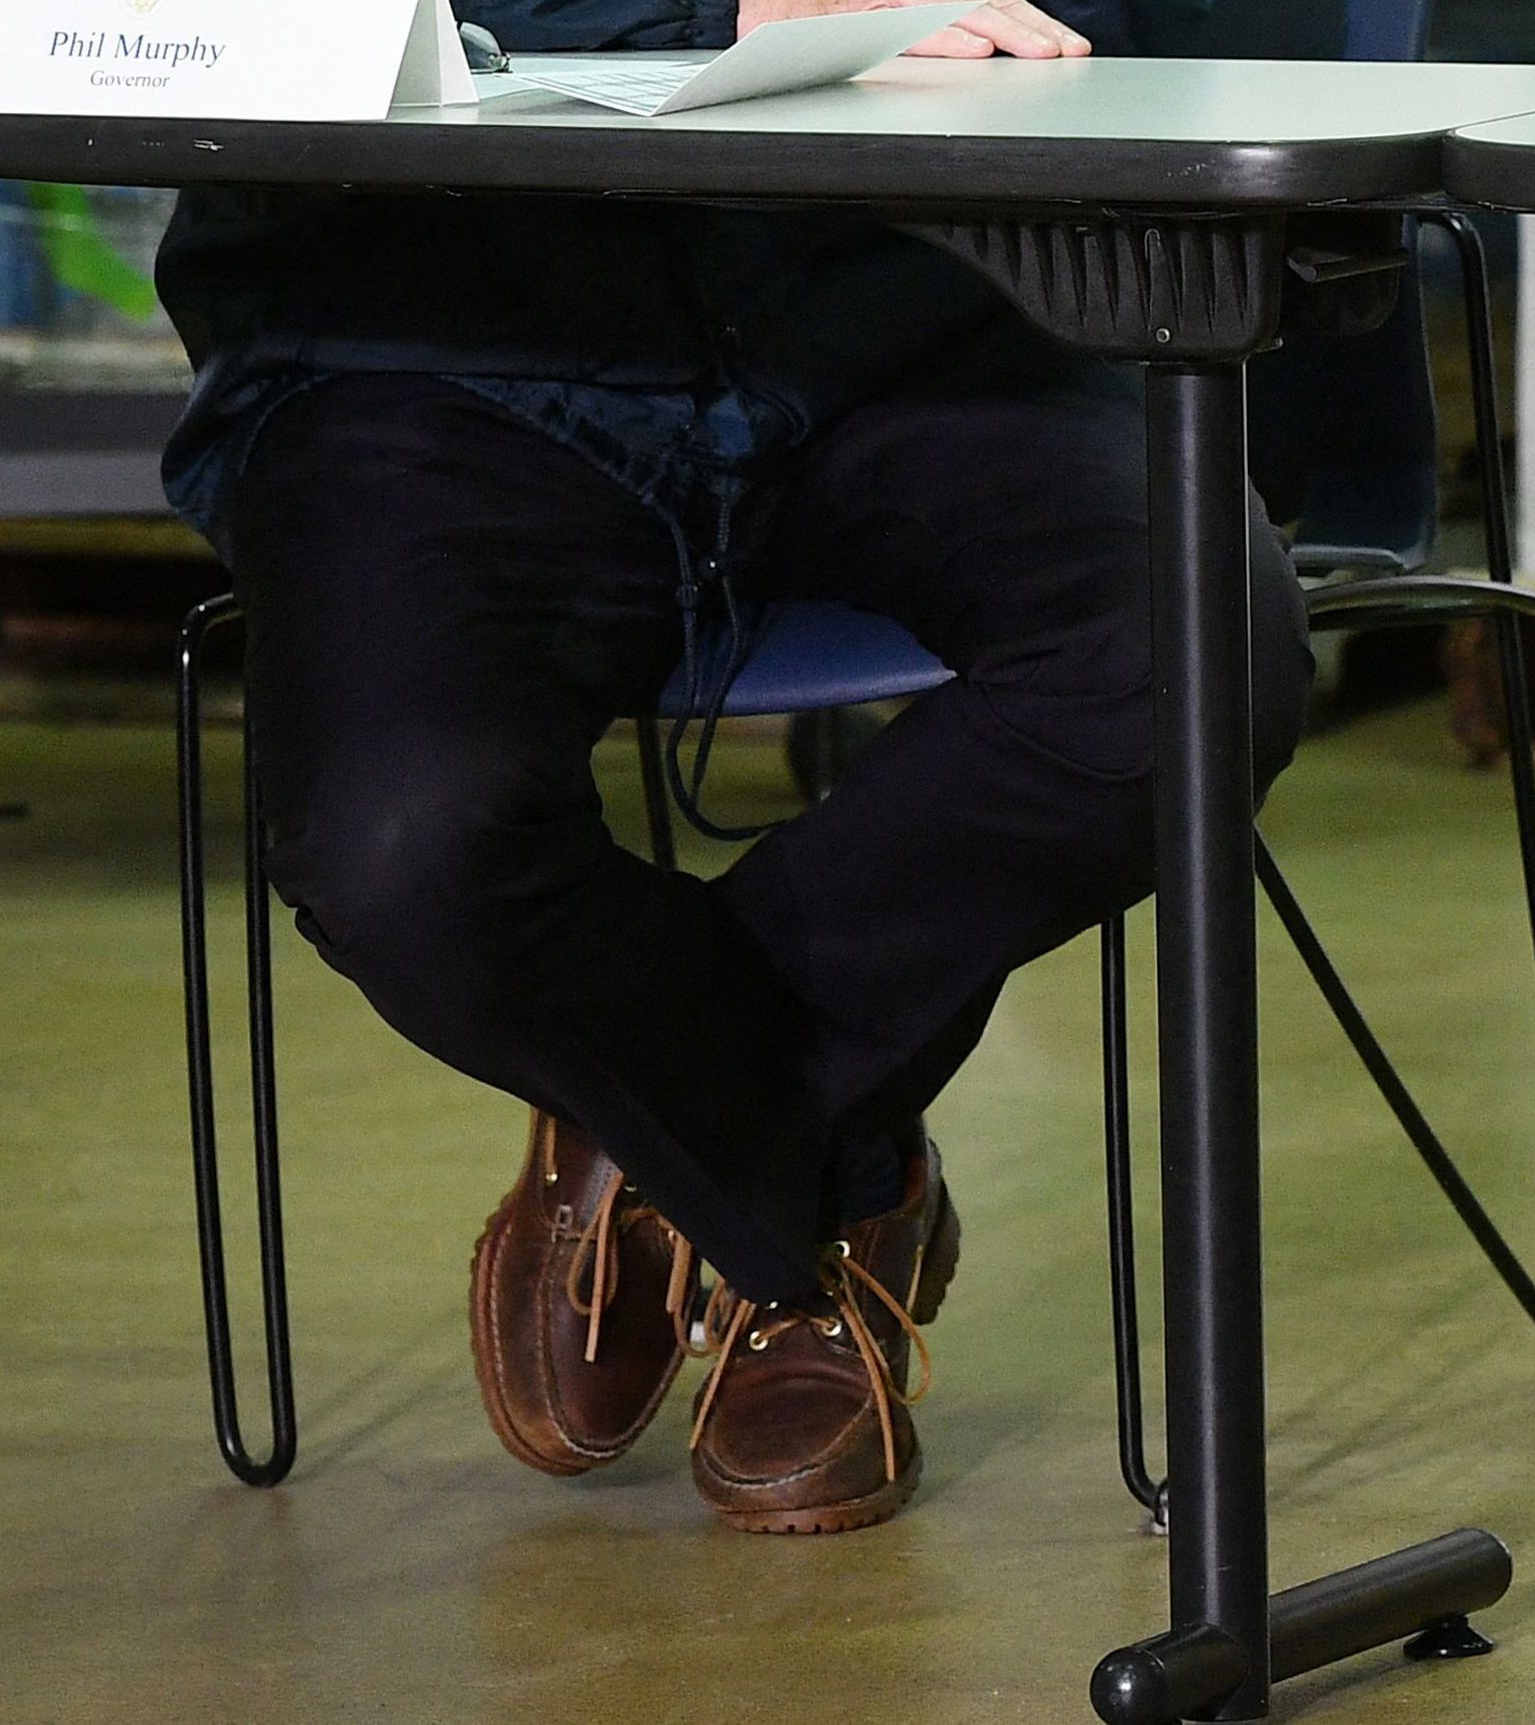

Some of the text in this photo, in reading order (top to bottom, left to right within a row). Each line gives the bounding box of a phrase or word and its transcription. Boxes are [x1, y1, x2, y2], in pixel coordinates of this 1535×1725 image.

[48, 31, 226, 68] Phil Murphy
[90, 70, 170, 87] Governor
